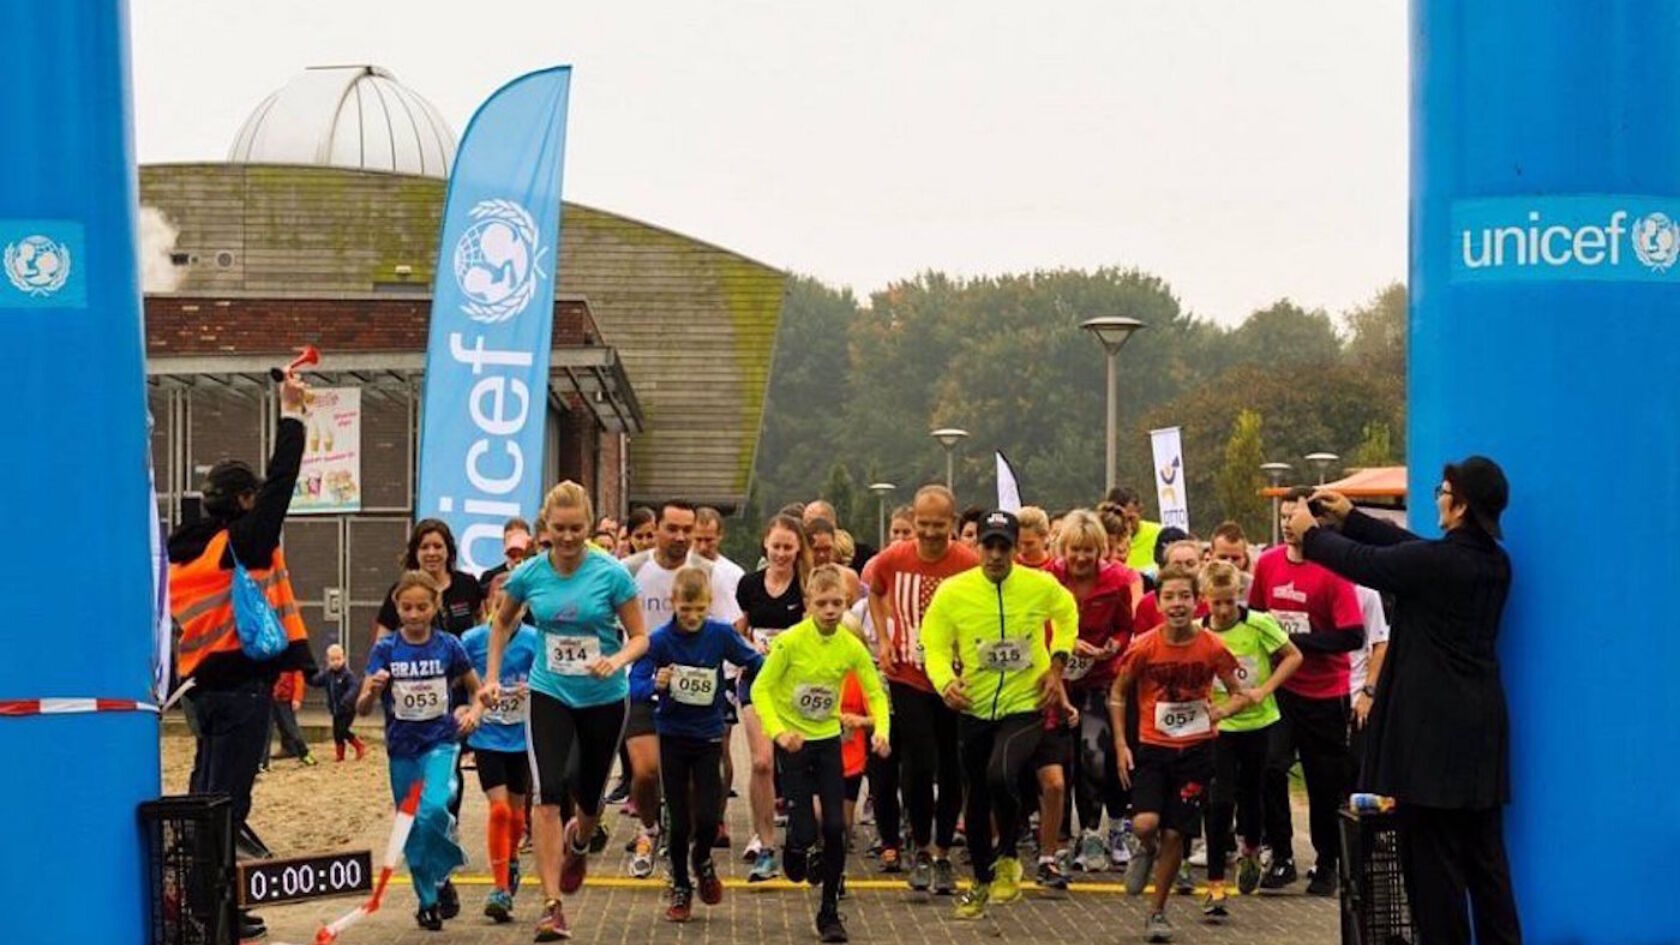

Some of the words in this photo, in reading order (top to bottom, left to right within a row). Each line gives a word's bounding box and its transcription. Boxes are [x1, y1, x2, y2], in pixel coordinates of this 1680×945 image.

[1463, 210, 1627, 268] unicef
[439, 331, 533, 580] nicef
[554, 647, 587, 661] 314
[987, 649, 1020, 662] 315
[390, 659, 445, 678] BRAZIL
[679, 677, 712, 693] 058
[404, 692, 438, 708] 053
[800, 694, 833, 710] 059
[1164, 710, 1197, 726] 057
[251, 859, 361, 900] 0:00:00
